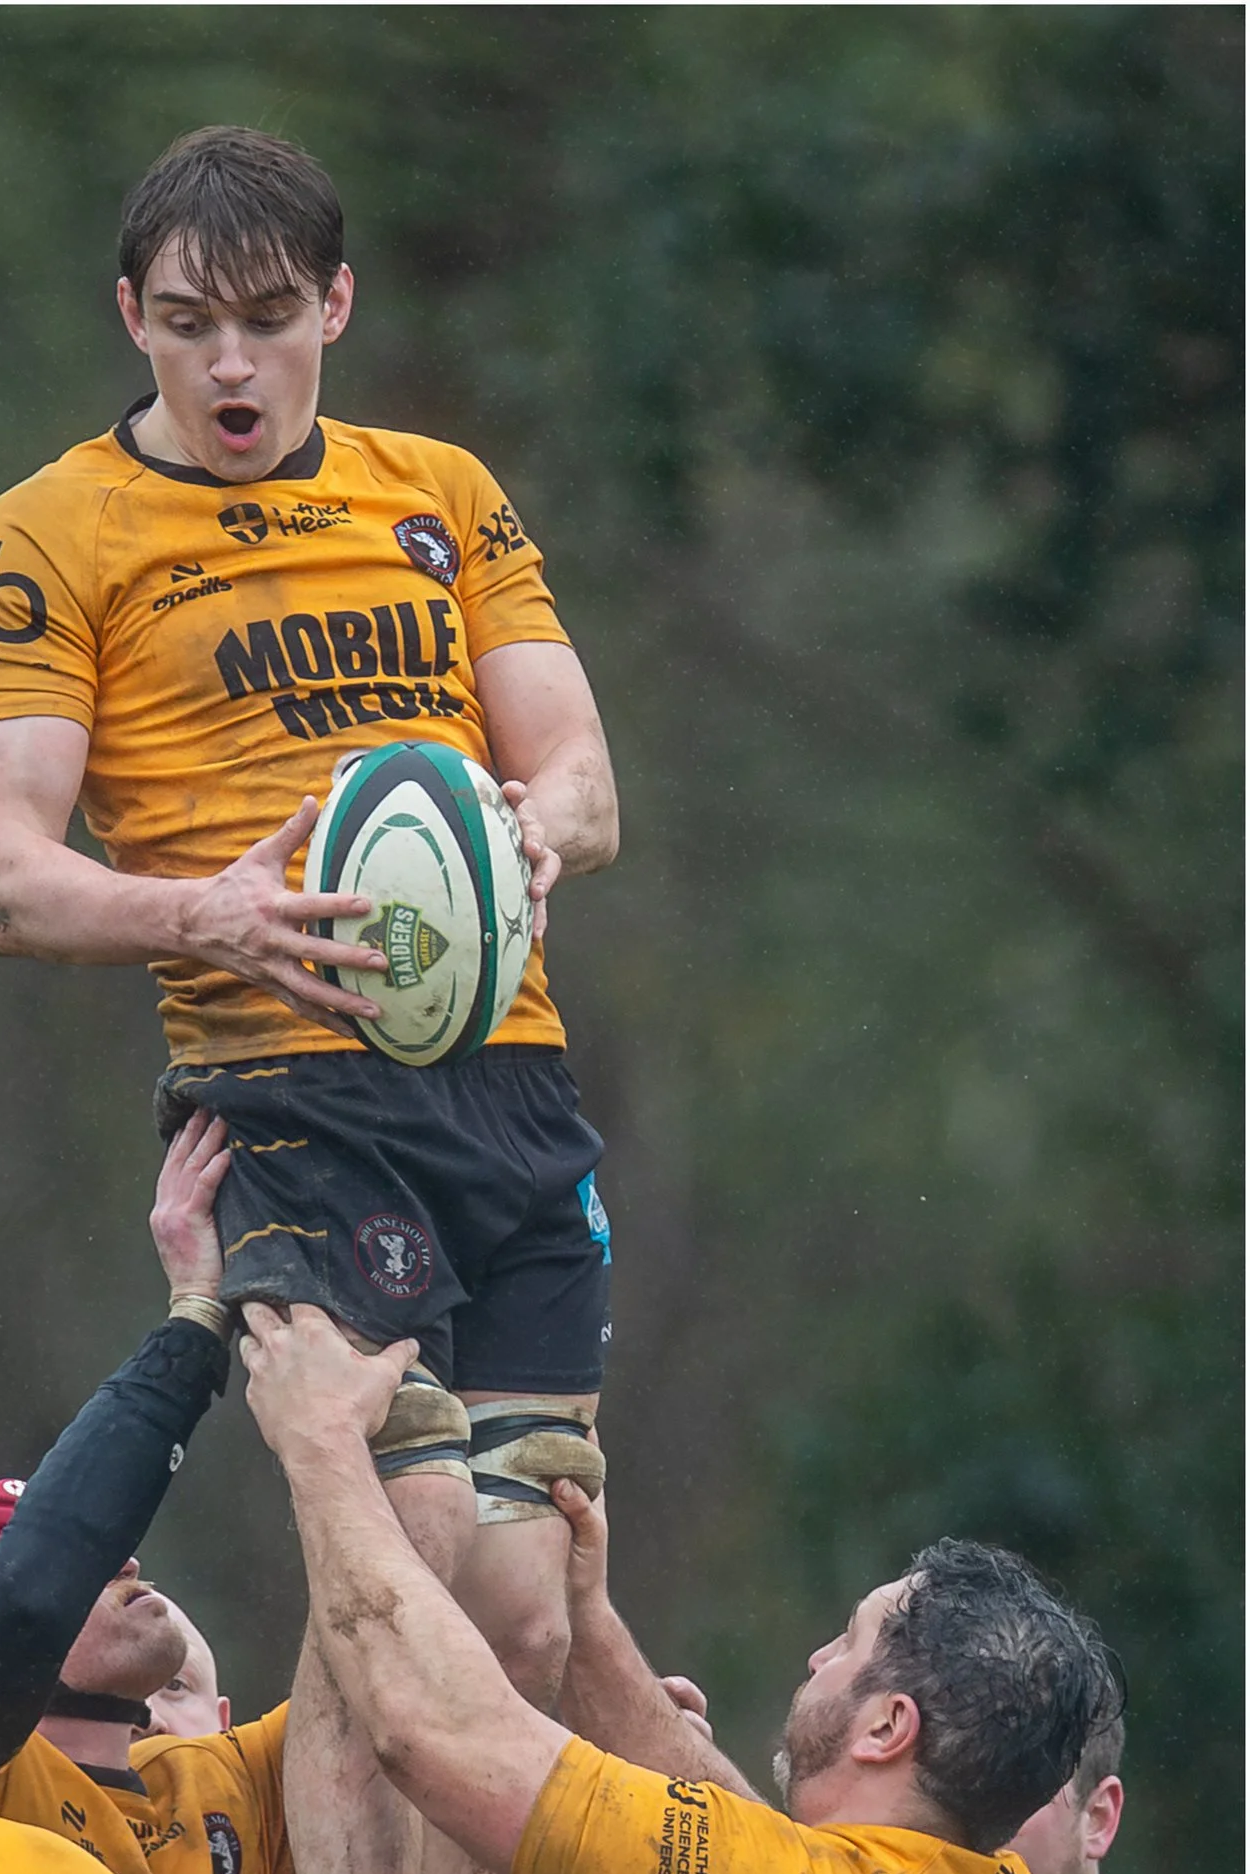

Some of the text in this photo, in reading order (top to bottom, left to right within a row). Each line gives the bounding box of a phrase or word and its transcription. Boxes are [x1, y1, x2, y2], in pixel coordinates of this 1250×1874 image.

[214, 599, 459, 700] MOBILE
[390, 907, 419, 987] RAIDERS
[358, 1217, 431, 1267] BOURNEMOUTH
[370, 1270, 411, 1295] RUGBY
